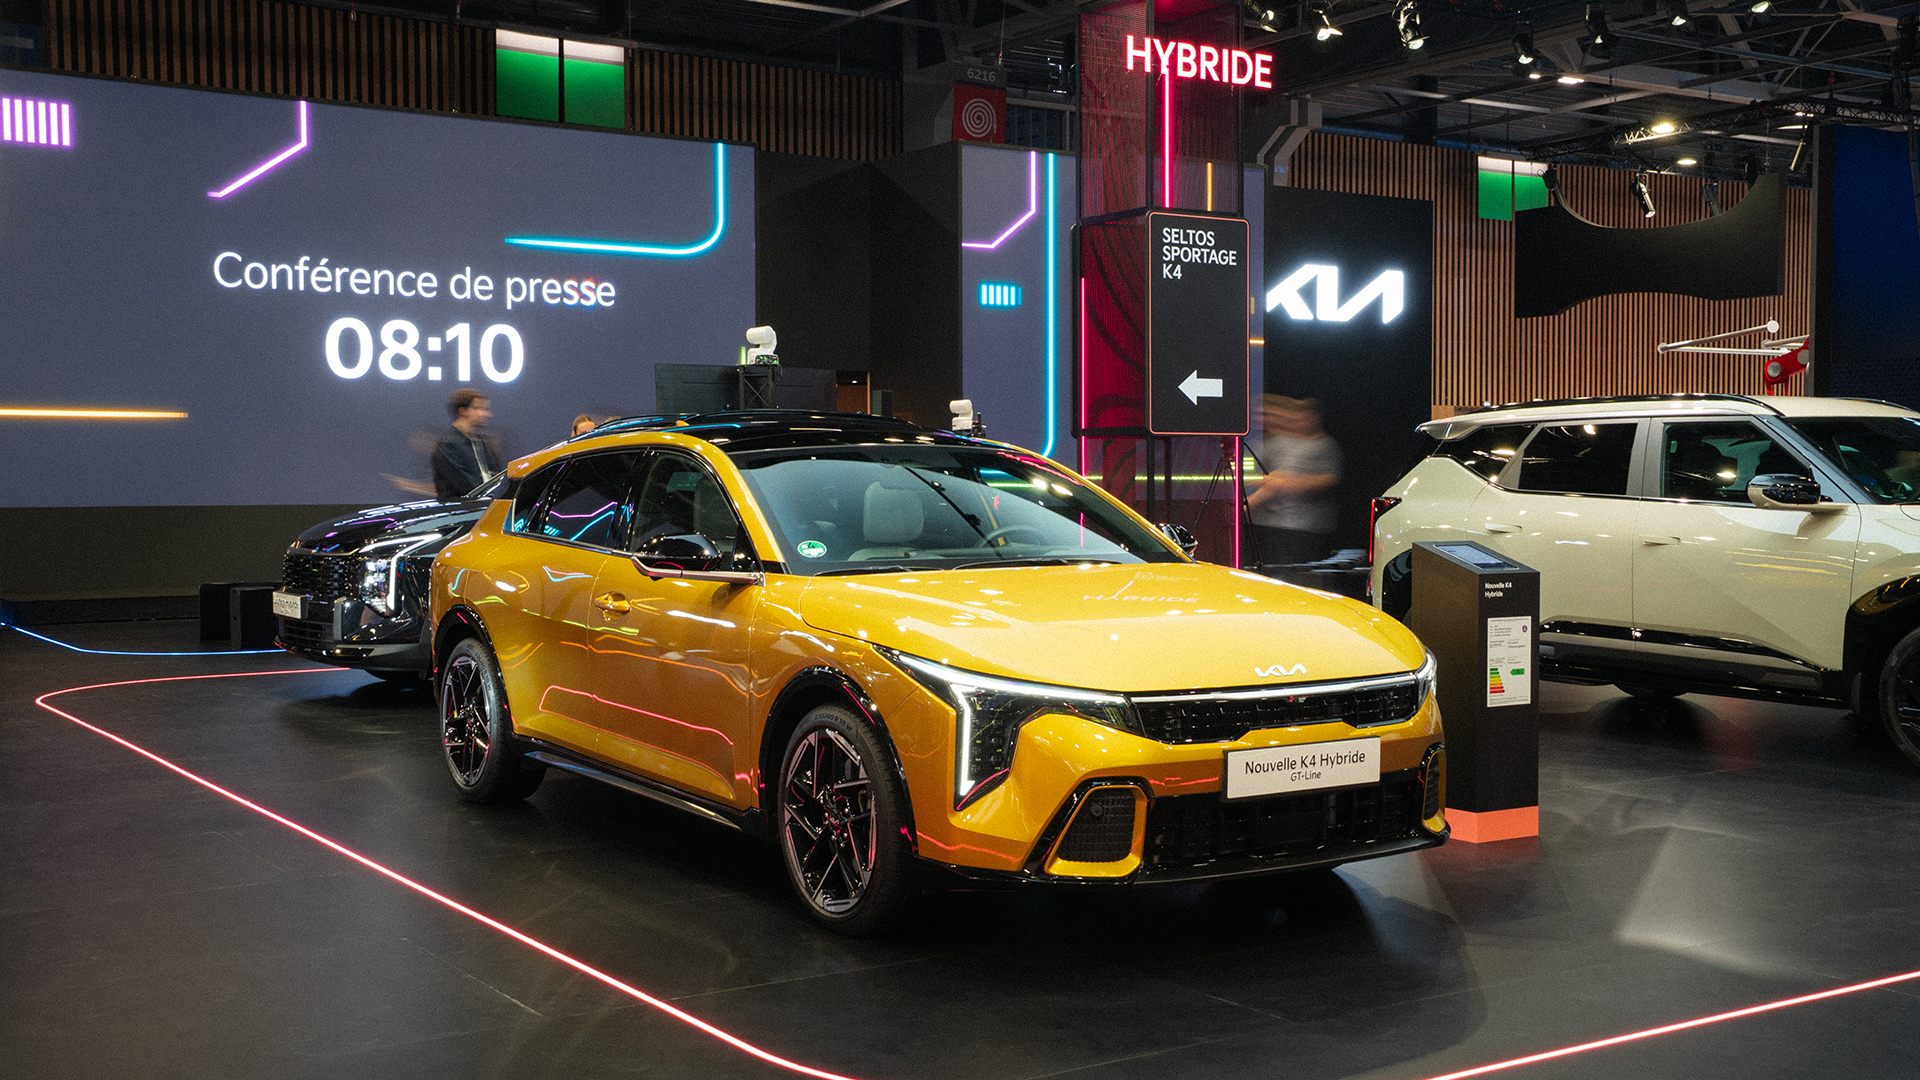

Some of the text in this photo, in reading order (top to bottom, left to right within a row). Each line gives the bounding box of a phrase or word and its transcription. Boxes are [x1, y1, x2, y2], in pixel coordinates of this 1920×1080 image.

[1126, 34, 1273, 89] HYBRIDE
[967, 68, 996, 82] 6216
[1162, 227, 1215, 247] SELTOS
[1162, 245, 1237, 266] SPORTAGE
[213, 251, 616, 310] Conférence de presse
[1162, 263, 1182, 280] K4
[1266, 264, 1404, 324] KIA
[324, 317, 525, 383] 08:10
[1254, 663, 1307, 677] KIA
[1245, 750, 1366, 774] Nouvelle K4 Hybride
[1290, 770, 1322, 782] GT-Line
